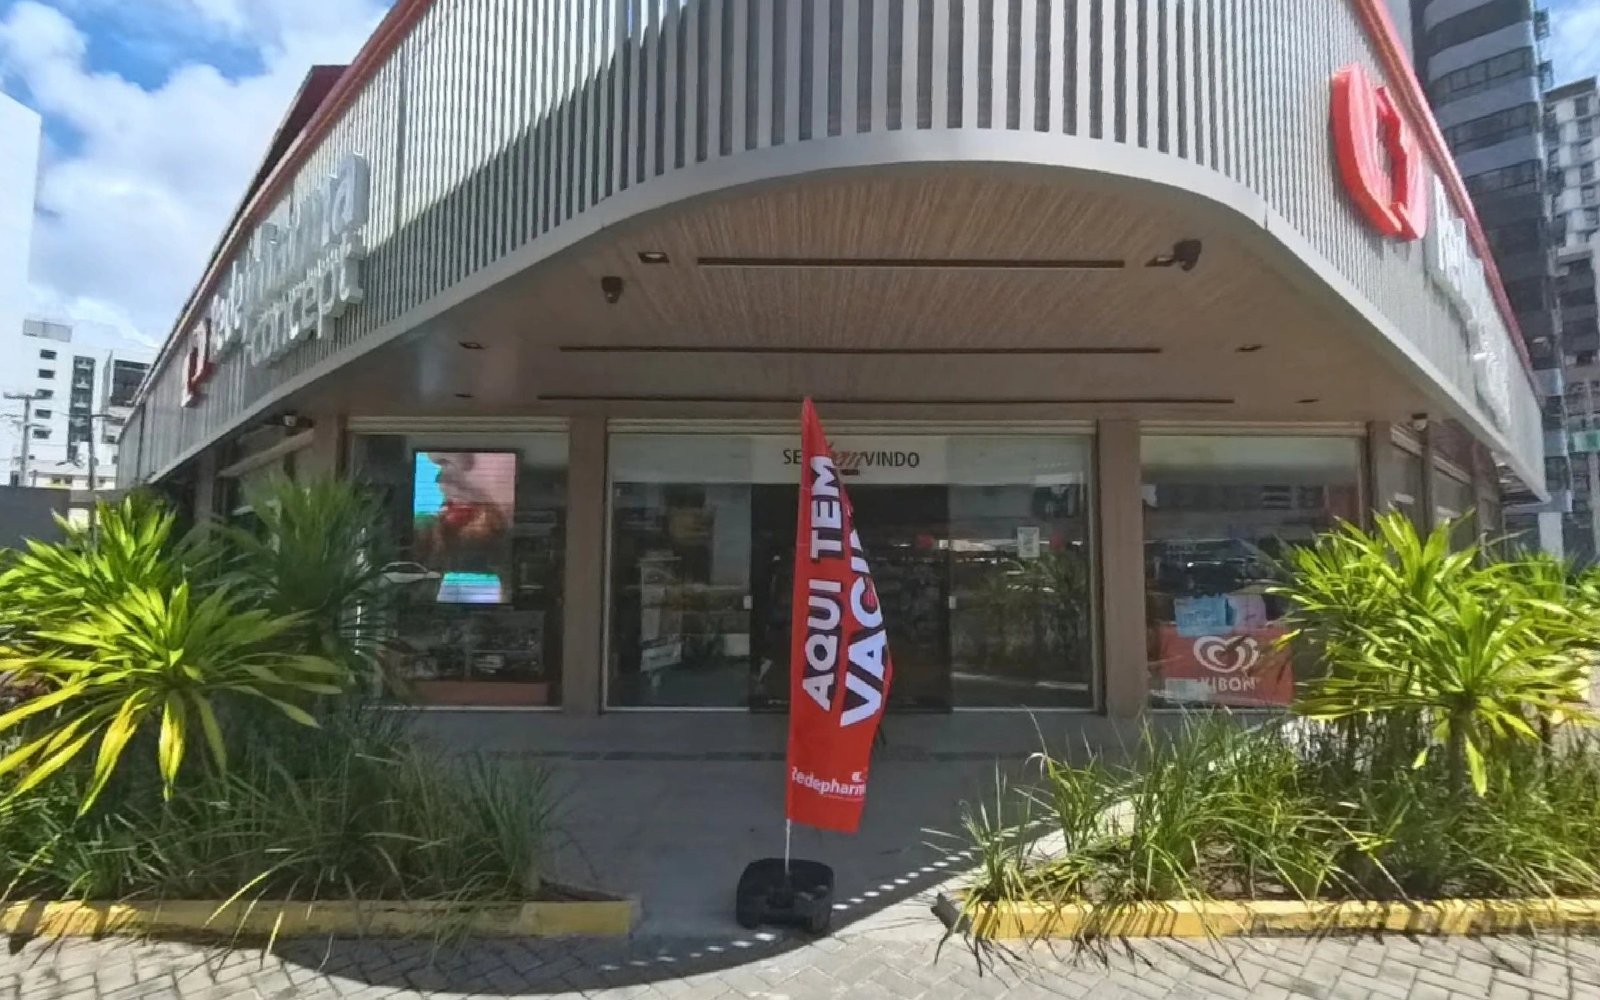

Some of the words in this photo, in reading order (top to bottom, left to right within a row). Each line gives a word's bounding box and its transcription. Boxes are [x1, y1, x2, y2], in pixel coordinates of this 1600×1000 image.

[809, 455, 842, 559] TEM
[865, 451, 920, 468] VINDO
[802, 578, 842, 711] AQUI
